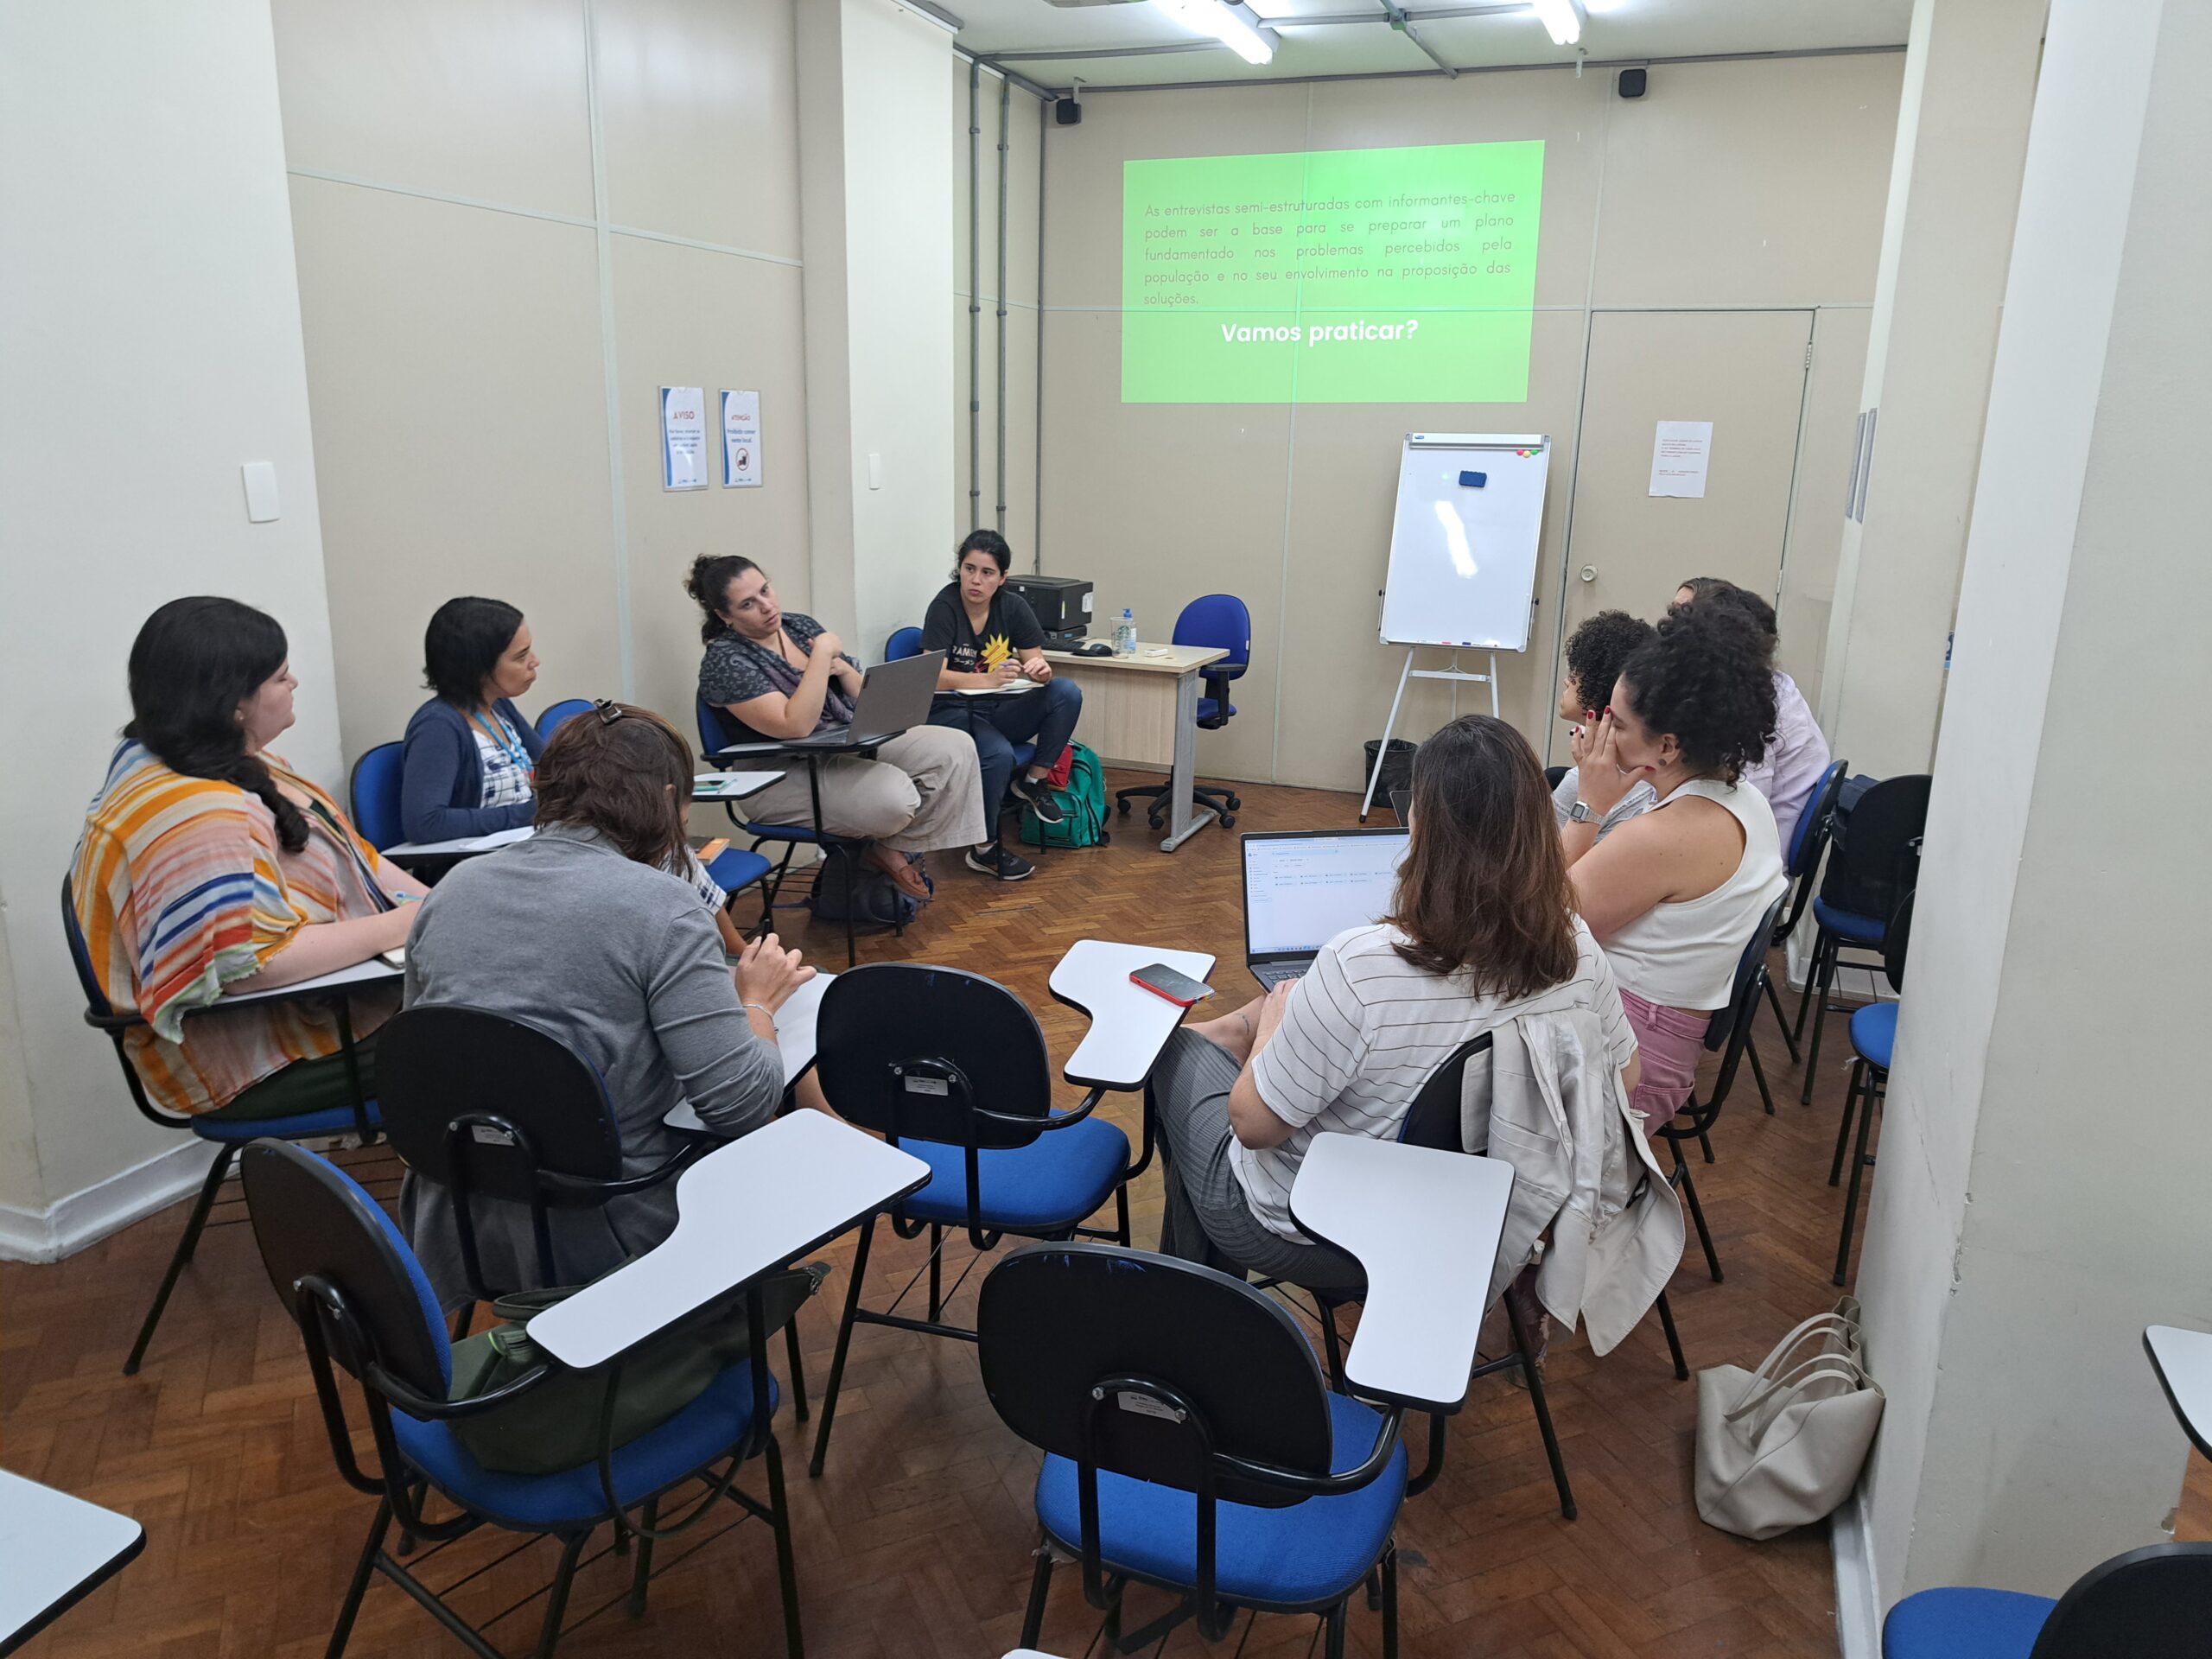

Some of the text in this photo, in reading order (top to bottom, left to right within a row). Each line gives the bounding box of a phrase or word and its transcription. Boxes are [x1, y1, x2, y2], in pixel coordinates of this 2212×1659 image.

[1145, 189, 1516, 217] As entrevistas semi-estruturadas com informantes-chave
[1145, 213, 1514, 243] podem ser a base para se preparar um plano
[1145, 236, 1512, 261] fundamentado nos problemas percebidos pela
[1144, 260, 1511, 286] população e no seu envolvimento na proposição das
[1143, 291, 1198, 308] soluções.
[1221, 319, 1419, 347] Vamos praticar?
[673, 410, 696, 420] AVISO
